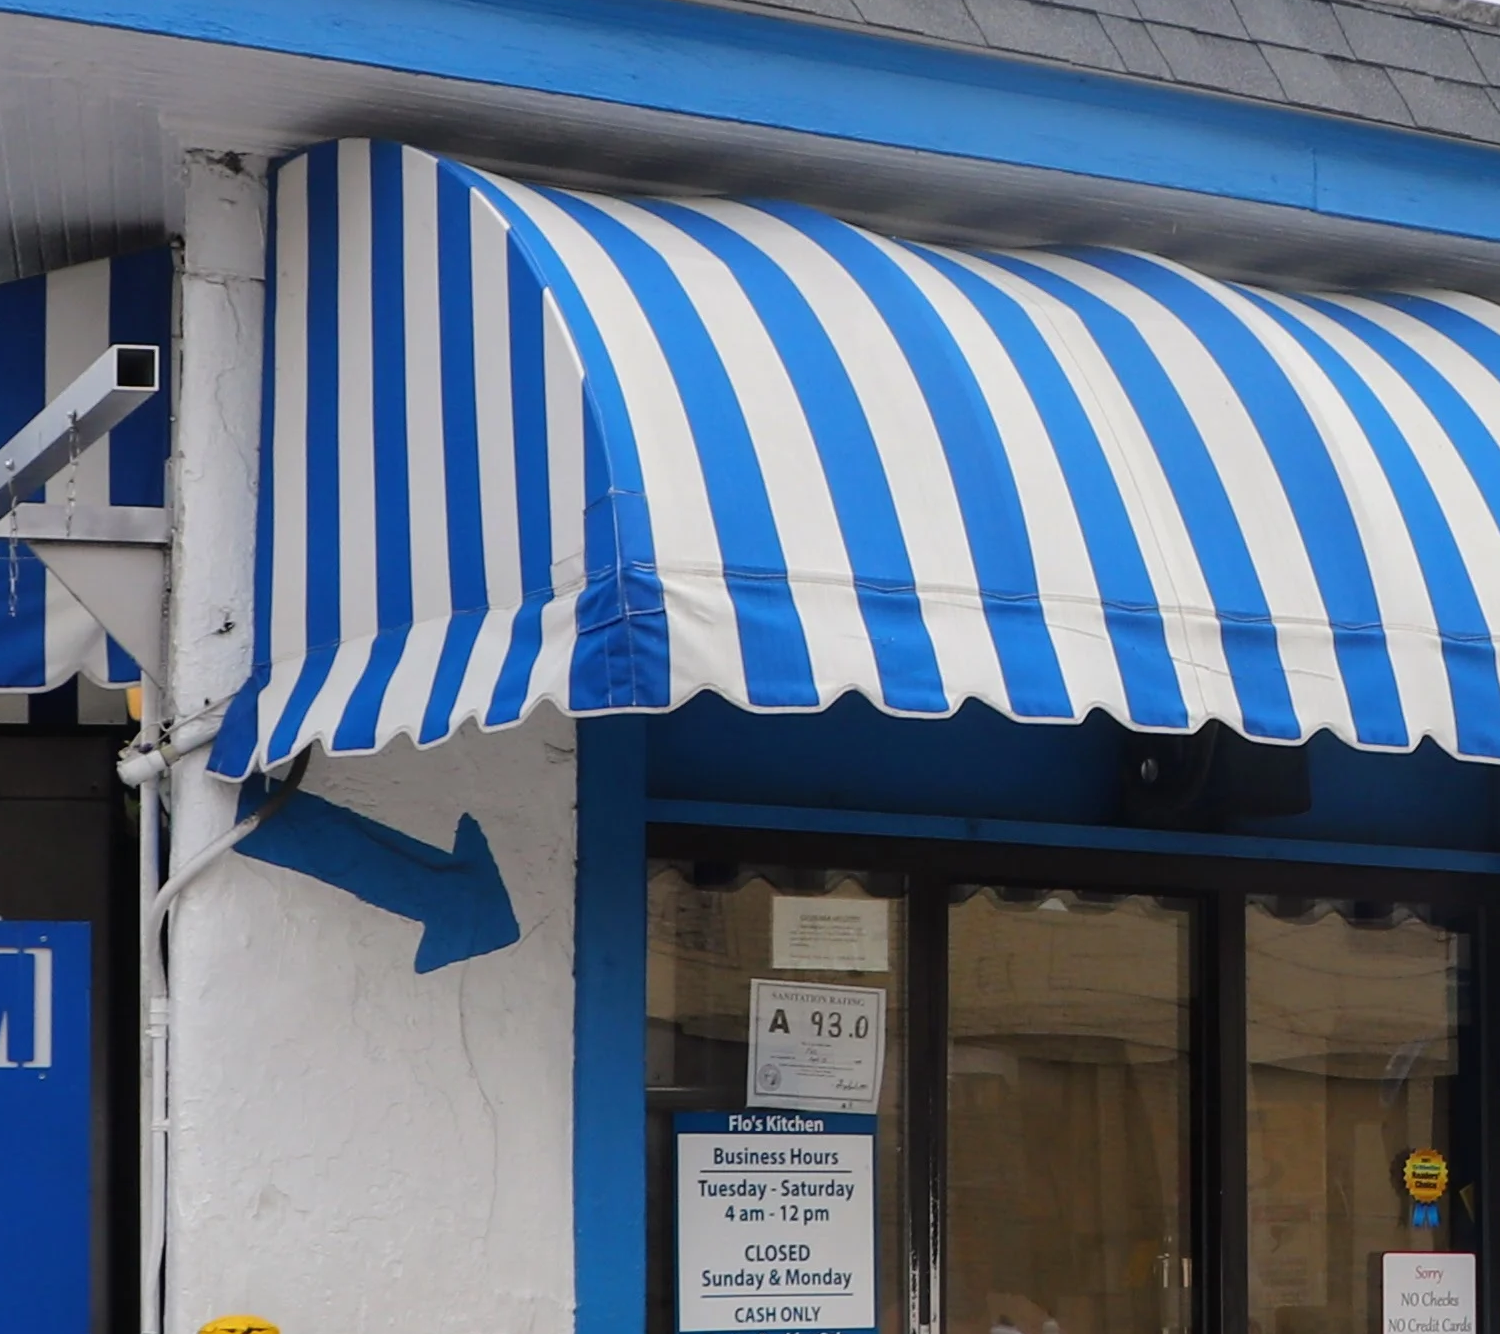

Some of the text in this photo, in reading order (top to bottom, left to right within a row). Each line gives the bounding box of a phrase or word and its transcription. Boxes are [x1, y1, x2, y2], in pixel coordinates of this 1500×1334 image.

[770, 991, 865, 1007] SANITATION RATING
[768, 1008, 791, 1035] A
[728, 1115, 824, 1132] Flo's Kitchen
[713, 1147, 839, 1165] Business Hours
[698, 1179, 767, 1201] Tuesday
[780, 1180, 854, 1201] Saturday
[724, 1205, 735, 1222] 4
[739, 1208, 765, 1222] am
[780, 1205, 799, 1221] 12
[803, 1207, 830, 1225] pm
[744, 1244, 811, 1262] CLOSED
[701, 1268, 852, 1290] Sunday & Monday
[1415, 1265, 1444, 1284] Sorry
[1401, 1291, 1459, 1307] NO Checks
[735, 1306, 821, 1323] CASH ONLY
[1388, 1316, 1472, 1333] NO Credit Cards
